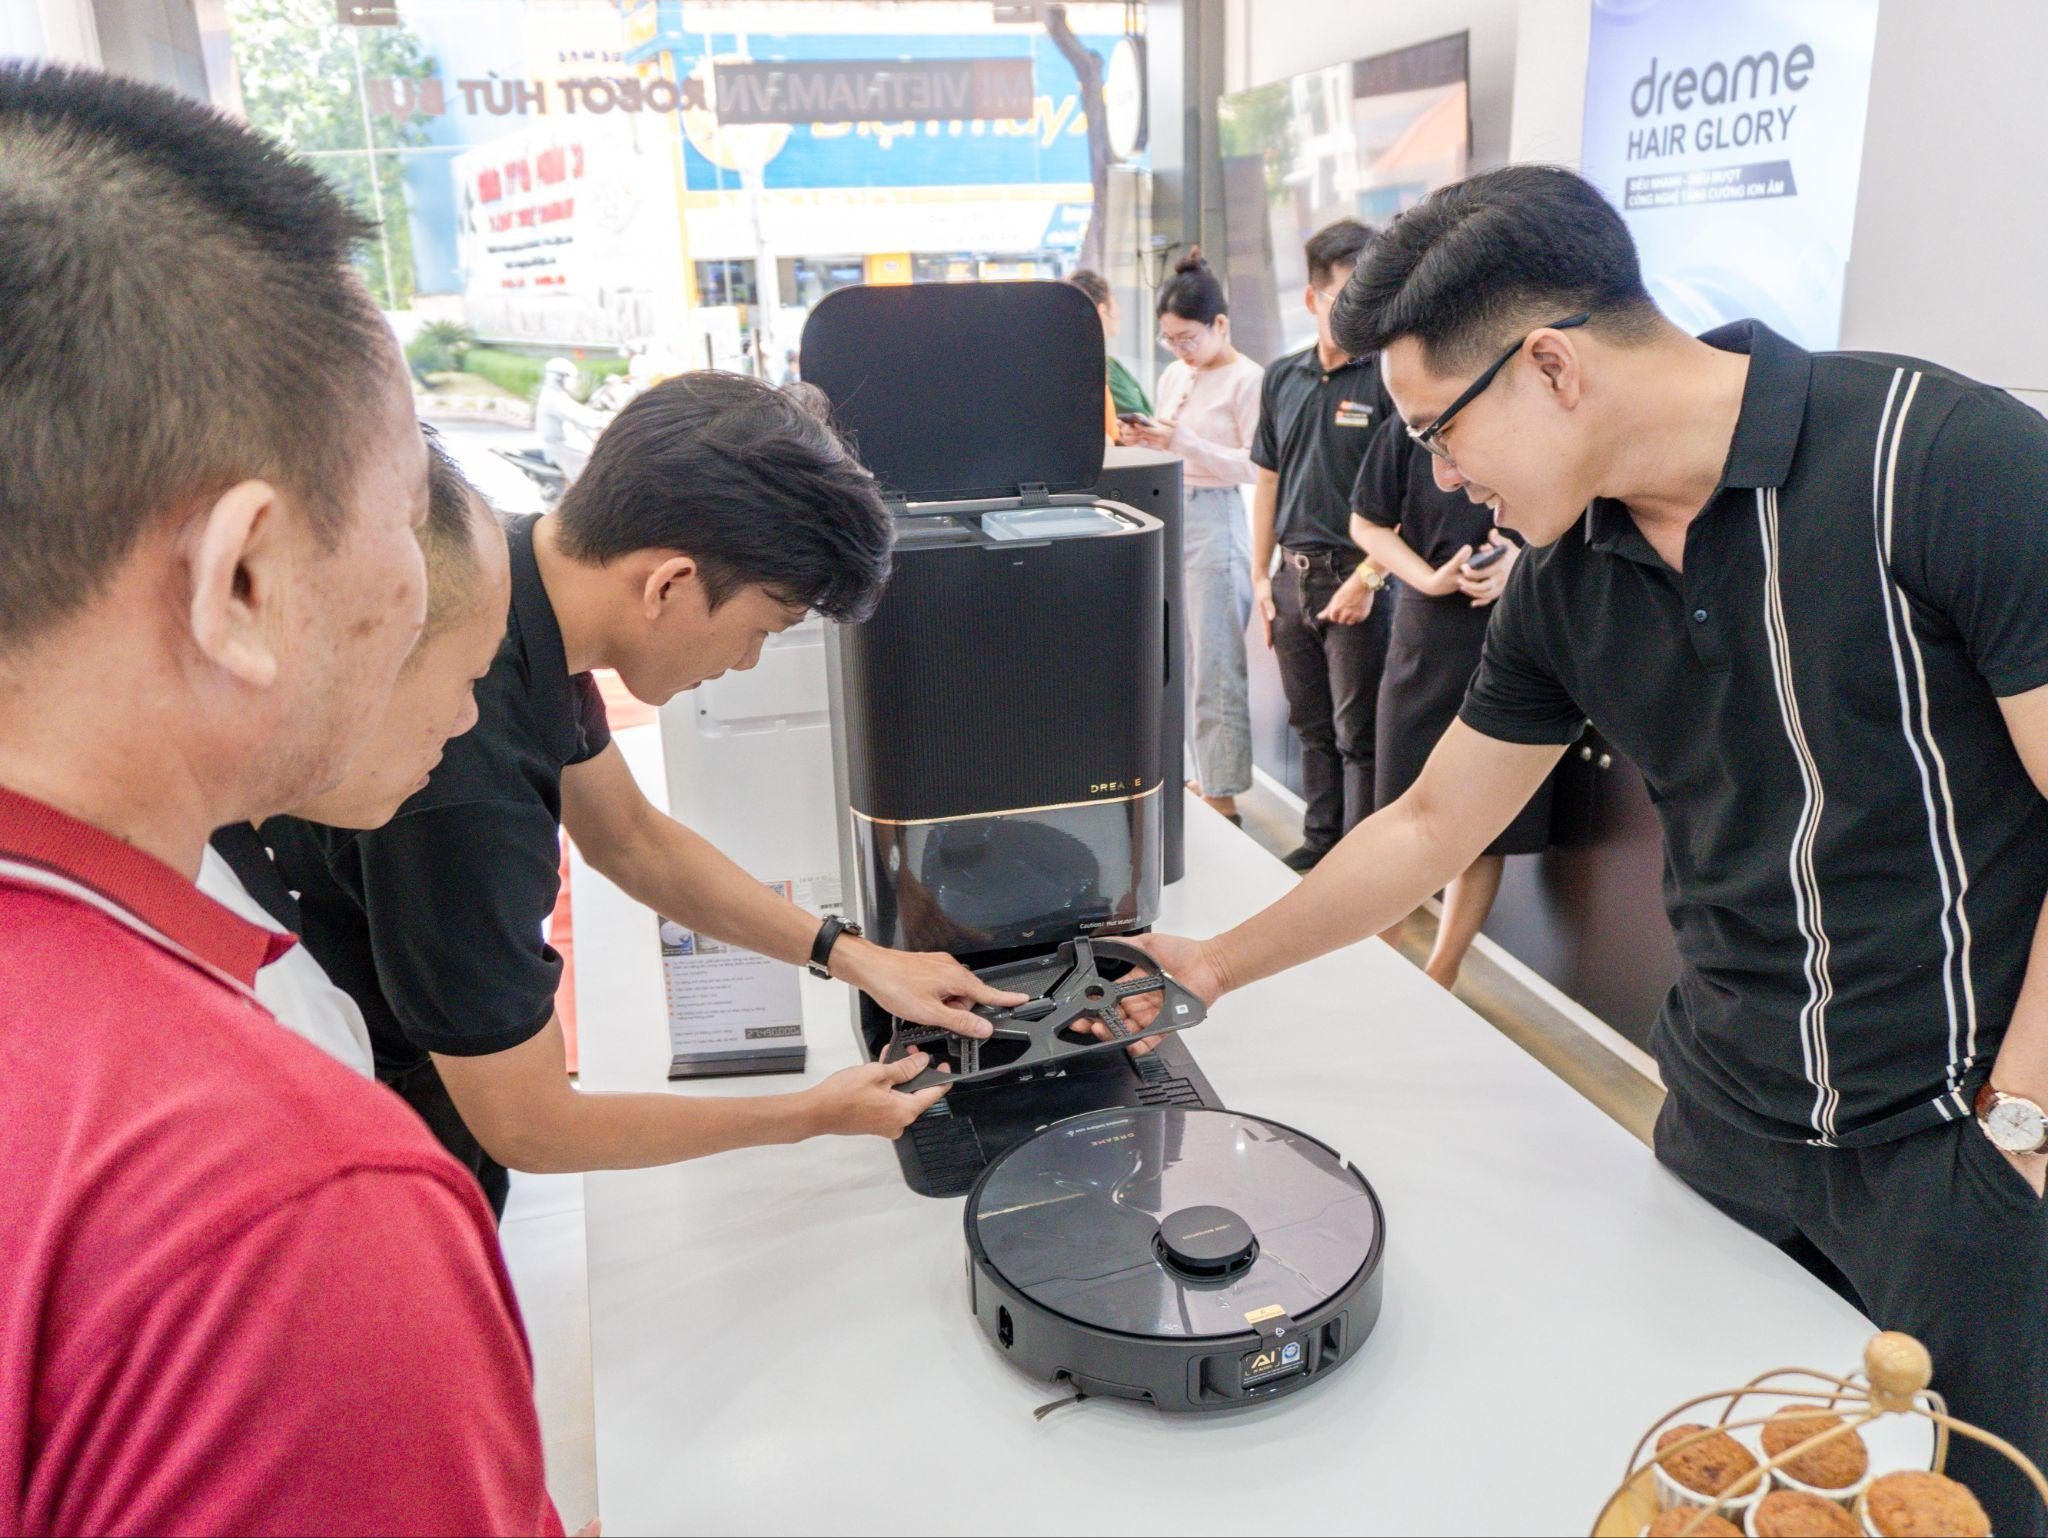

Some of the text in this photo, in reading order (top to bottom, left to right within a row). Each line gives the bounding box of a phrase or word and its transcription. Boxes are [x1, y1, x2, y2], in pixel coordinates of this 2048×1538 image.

[1631, 43, 1815, 118] dreame
[1627, 104, 1797, 162] HAIR GLORY
[1090, 777, 1142, 793] DREAE
[1250, 1350, 1276, 1369] AI
